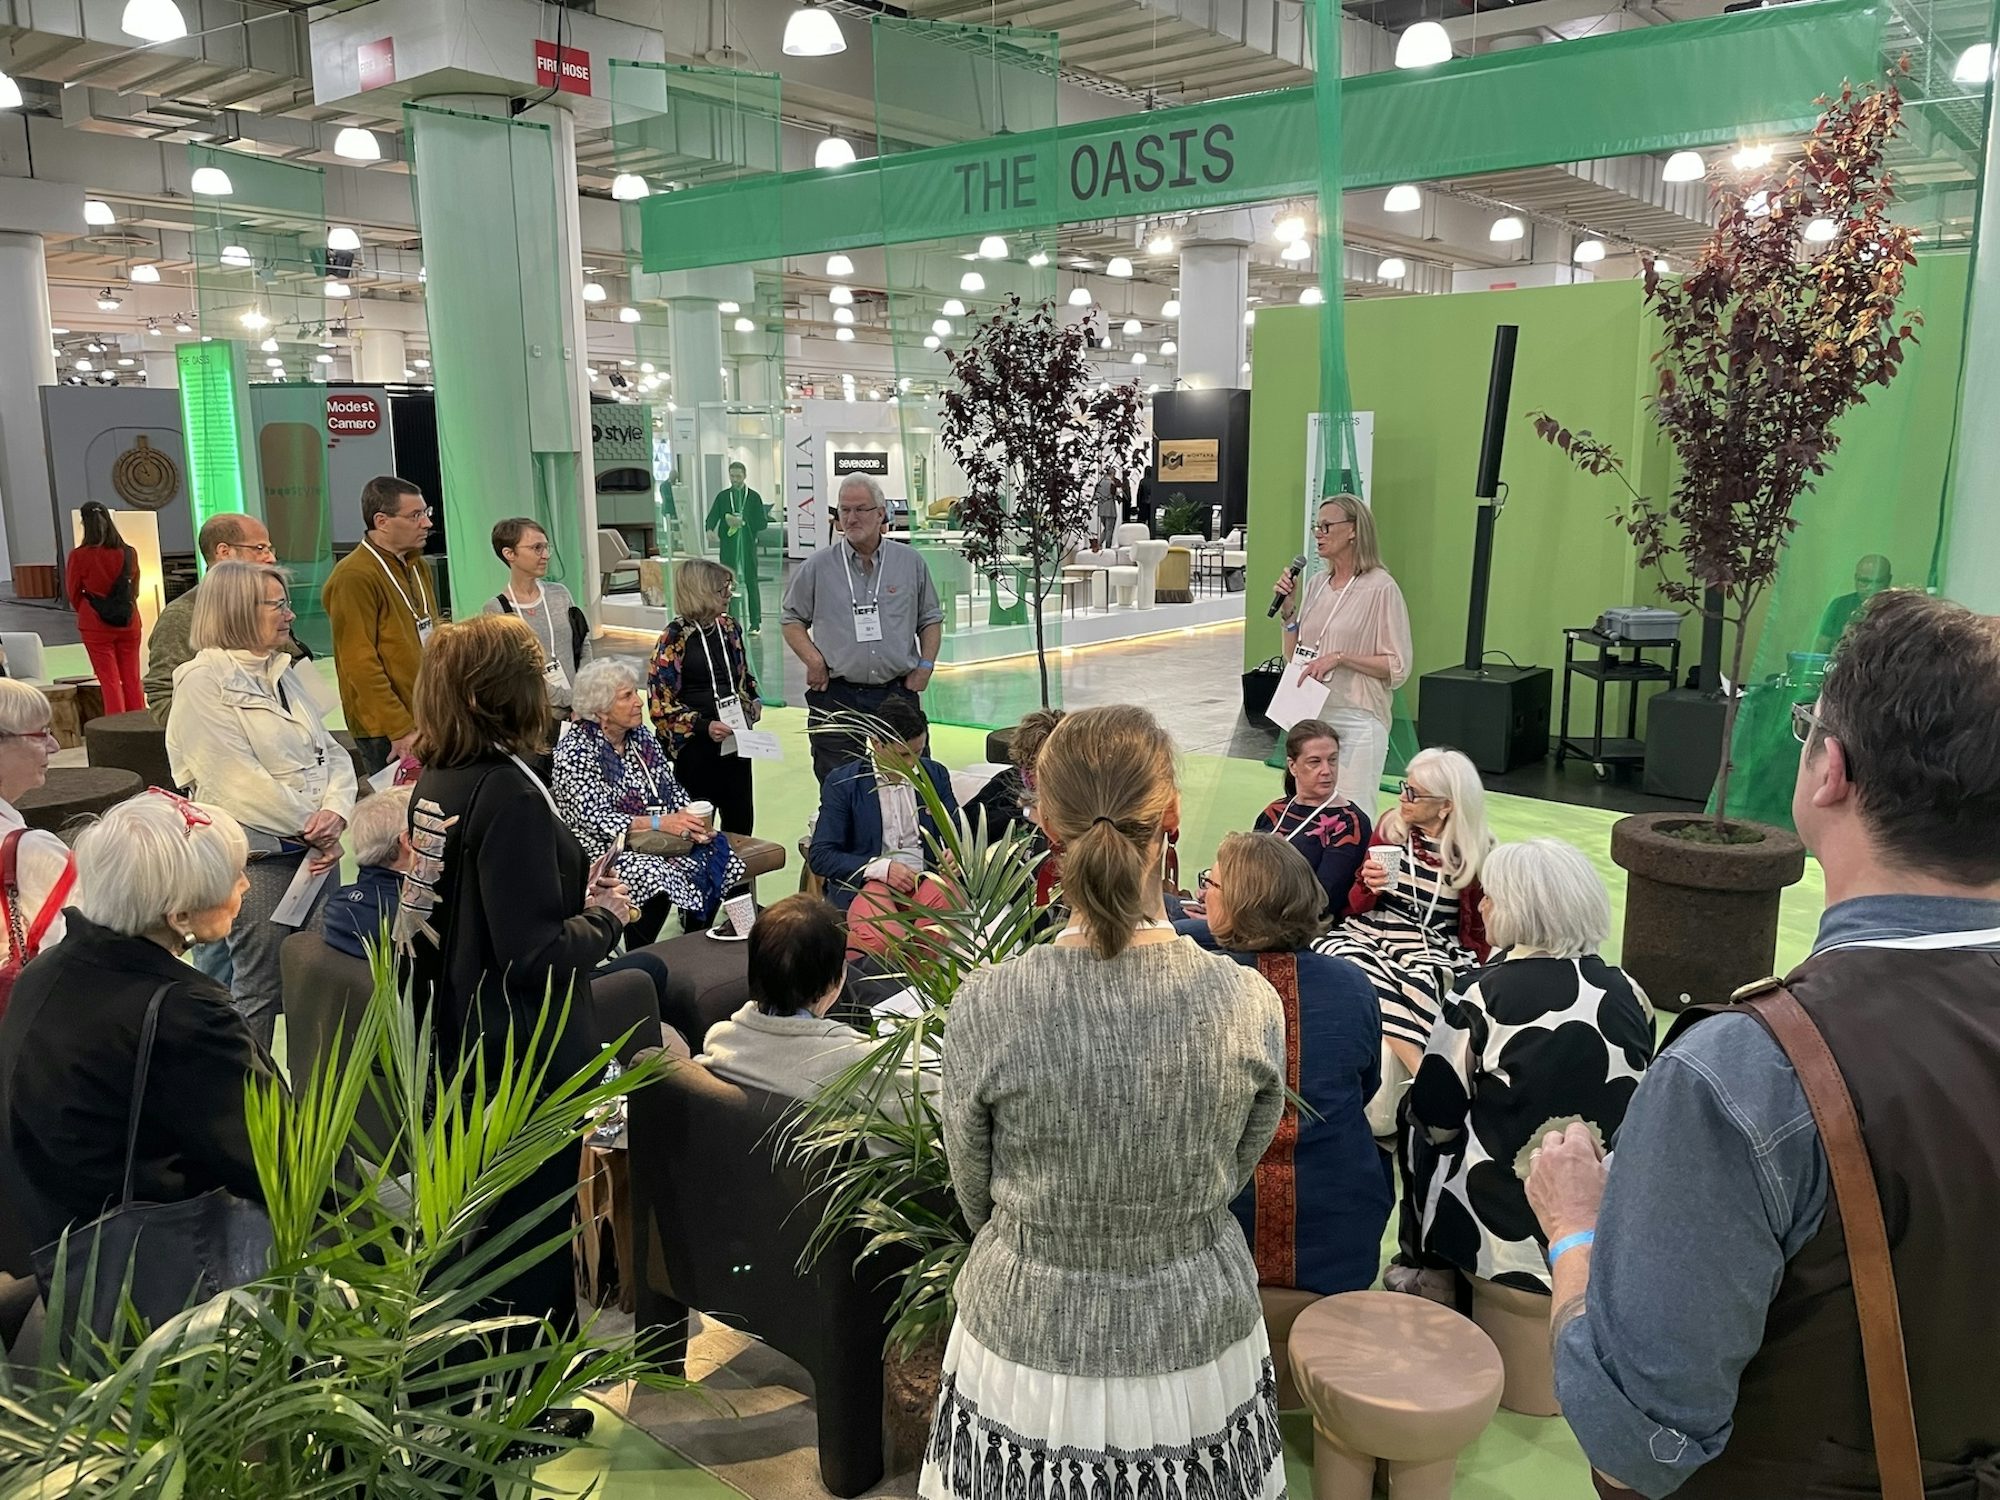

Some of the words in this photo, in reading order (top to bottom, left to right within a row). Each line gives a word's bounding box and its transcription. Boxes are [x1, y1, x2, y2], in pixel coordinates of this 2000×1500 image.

[562, 62, 590, 80] HOSE
[953, 154, 1037, 215] THE
[1070, 123, 1235, 200] OASIS
[326, 401, 375, 413] Modest
[796, 434, 816, 551] ITALIA
